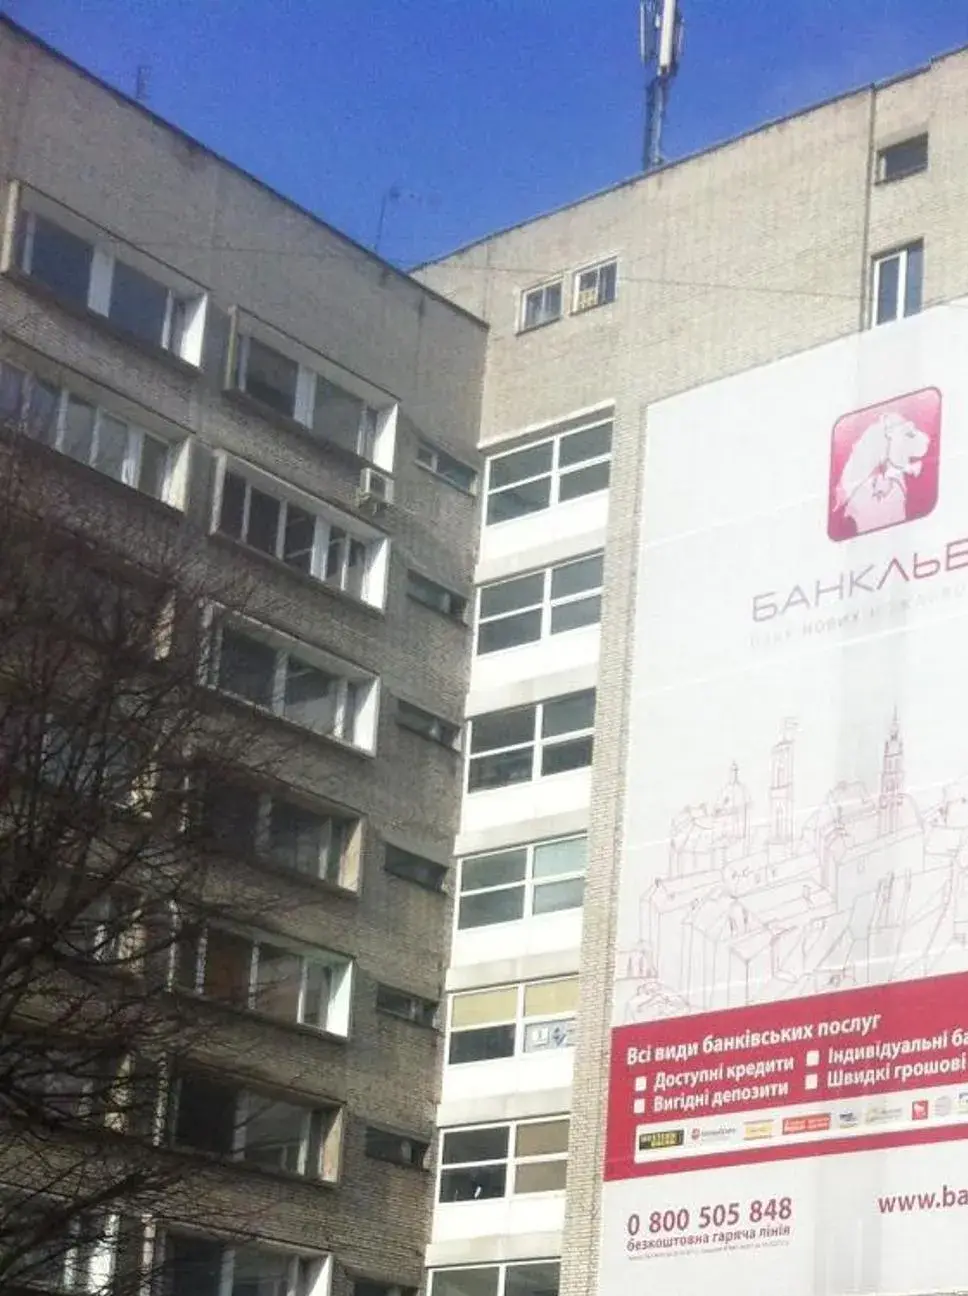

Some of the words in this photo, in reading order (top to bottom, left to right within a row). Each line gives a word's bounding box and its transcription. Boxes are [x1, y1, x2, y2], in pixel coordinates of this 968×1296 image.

[627, 1045, 651, 1065] Всі
[655, 1041, 698, 1061] види
[703, 1023, 813, 1054] банківських
[818, 1014, 881, 1036] послуг
[828, 1030, 948, 1064] Індивідуальні
[654, 1063, 723, 1091] Доступні
[727, 1057, 794, 1081] кредити
[828, 1068, 891, 1089] Швидкі
[894, 1053, 967, 1082] грошові
[654, 1091, 709, 1112] Вигідні
[712, 1081, 788, 1106] депозити
[628, 1214, 640, 1235] 0
[649, 1208, 689, 1233] 800
[698, 1203, 740, 1229] 505
[749, 1197, 792, 1223] 848
[627, 1232, 709, 1252] безкоштовна
[713, 1229, 756, 1246] гаряча
[759, 1224, 790, 1238] лінія
